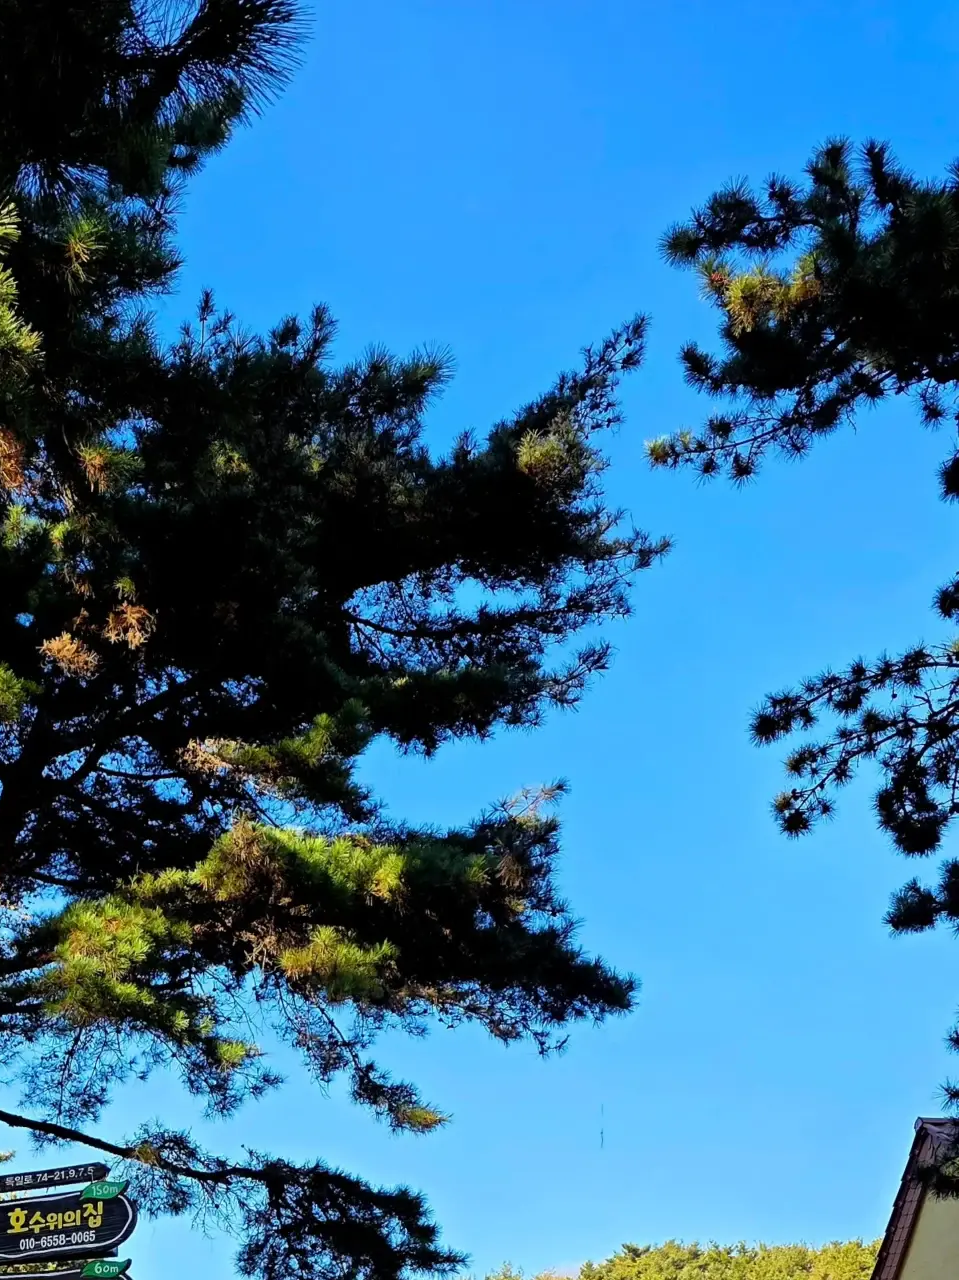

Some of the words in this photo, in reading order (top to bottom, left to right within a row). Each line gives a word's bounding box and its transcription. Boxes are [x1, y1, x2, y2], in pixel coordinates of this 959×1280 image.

[5, 1175, 33, 1187] 독일로
[91, 1184, 118, 1197] 150m
[19, 1230, 96, 1250] 010-6558-0065
[94, 1262, 119, 1274] 60m
